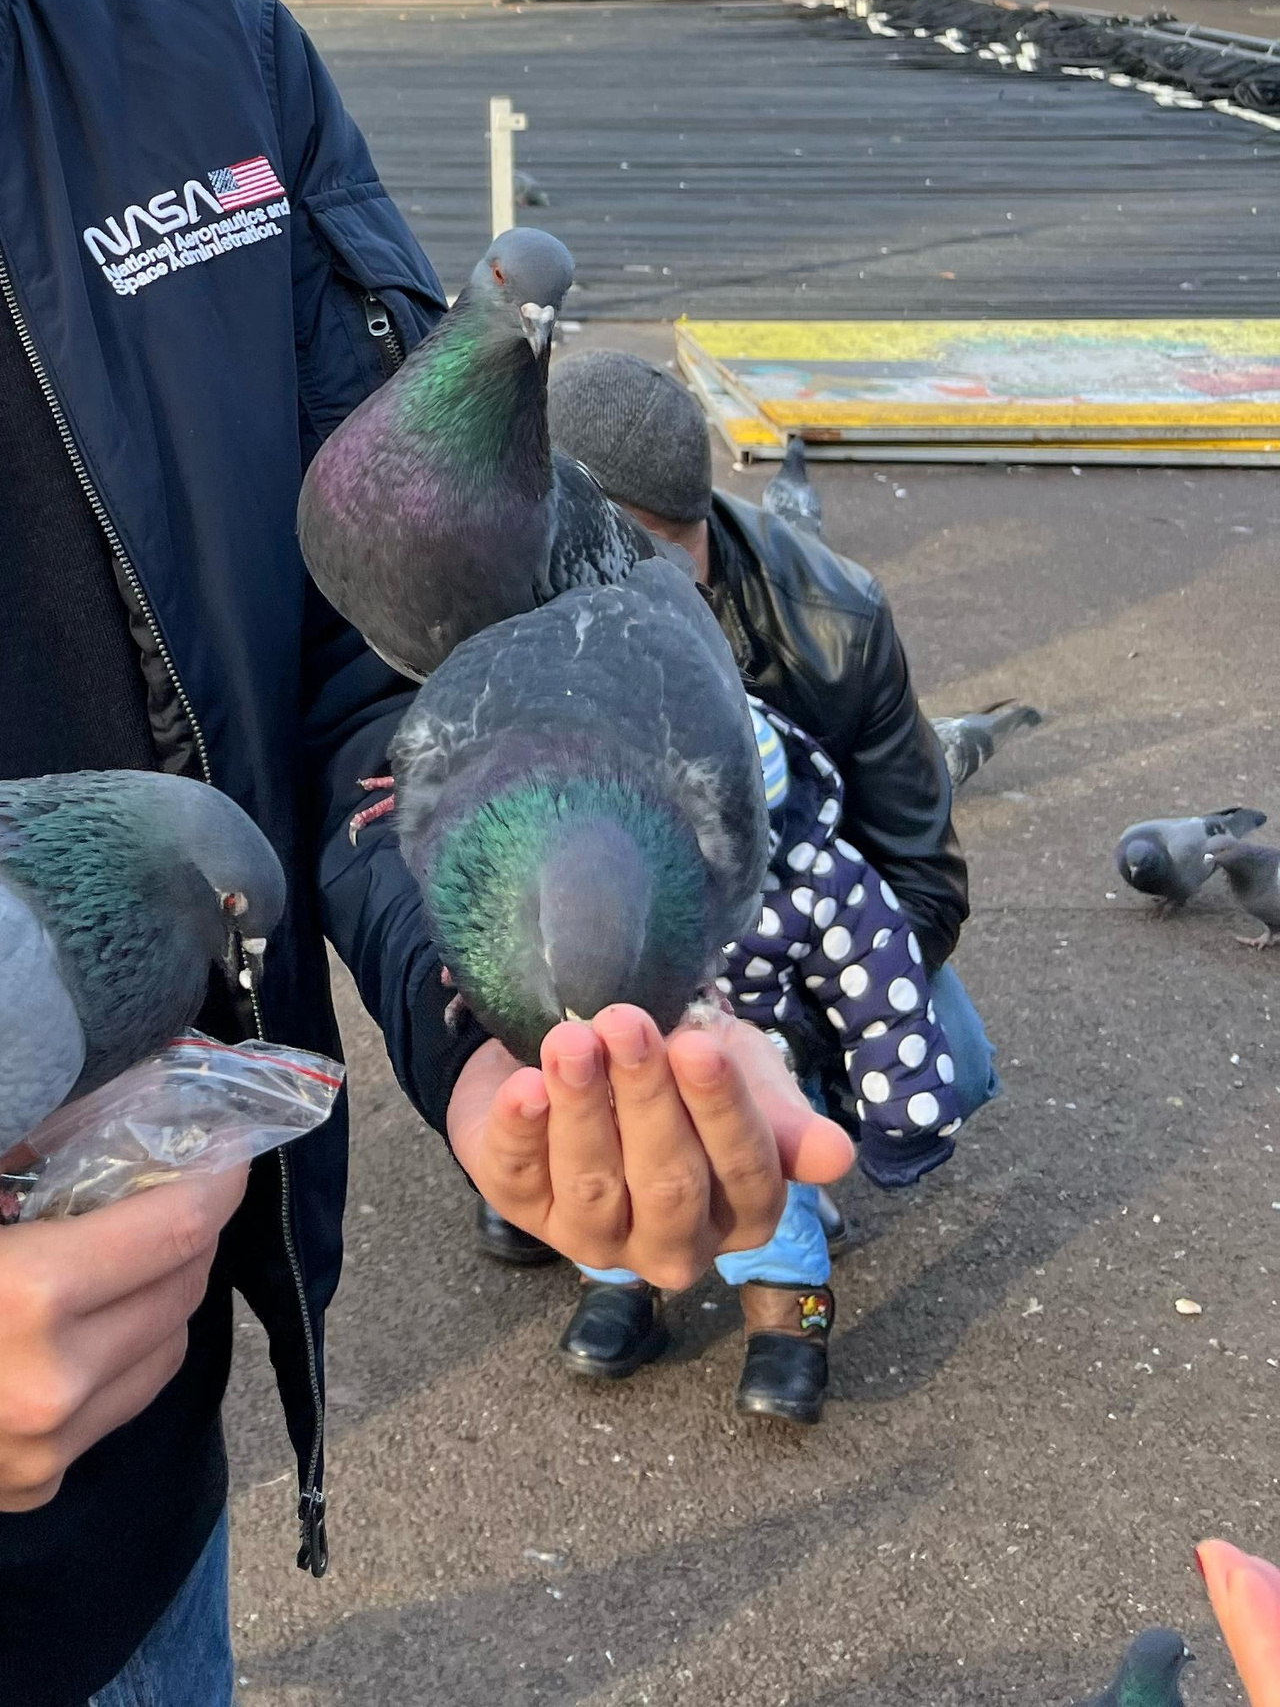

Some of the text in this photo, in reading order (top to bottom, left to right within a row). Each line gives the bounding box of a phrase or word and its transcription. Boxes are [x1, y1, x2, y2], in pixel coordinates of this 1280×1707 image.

[83, 180, 225, 265] NASA
[102, 196, 291, 282] National Aeronautics and
[112, 262, 169, 296] Space
